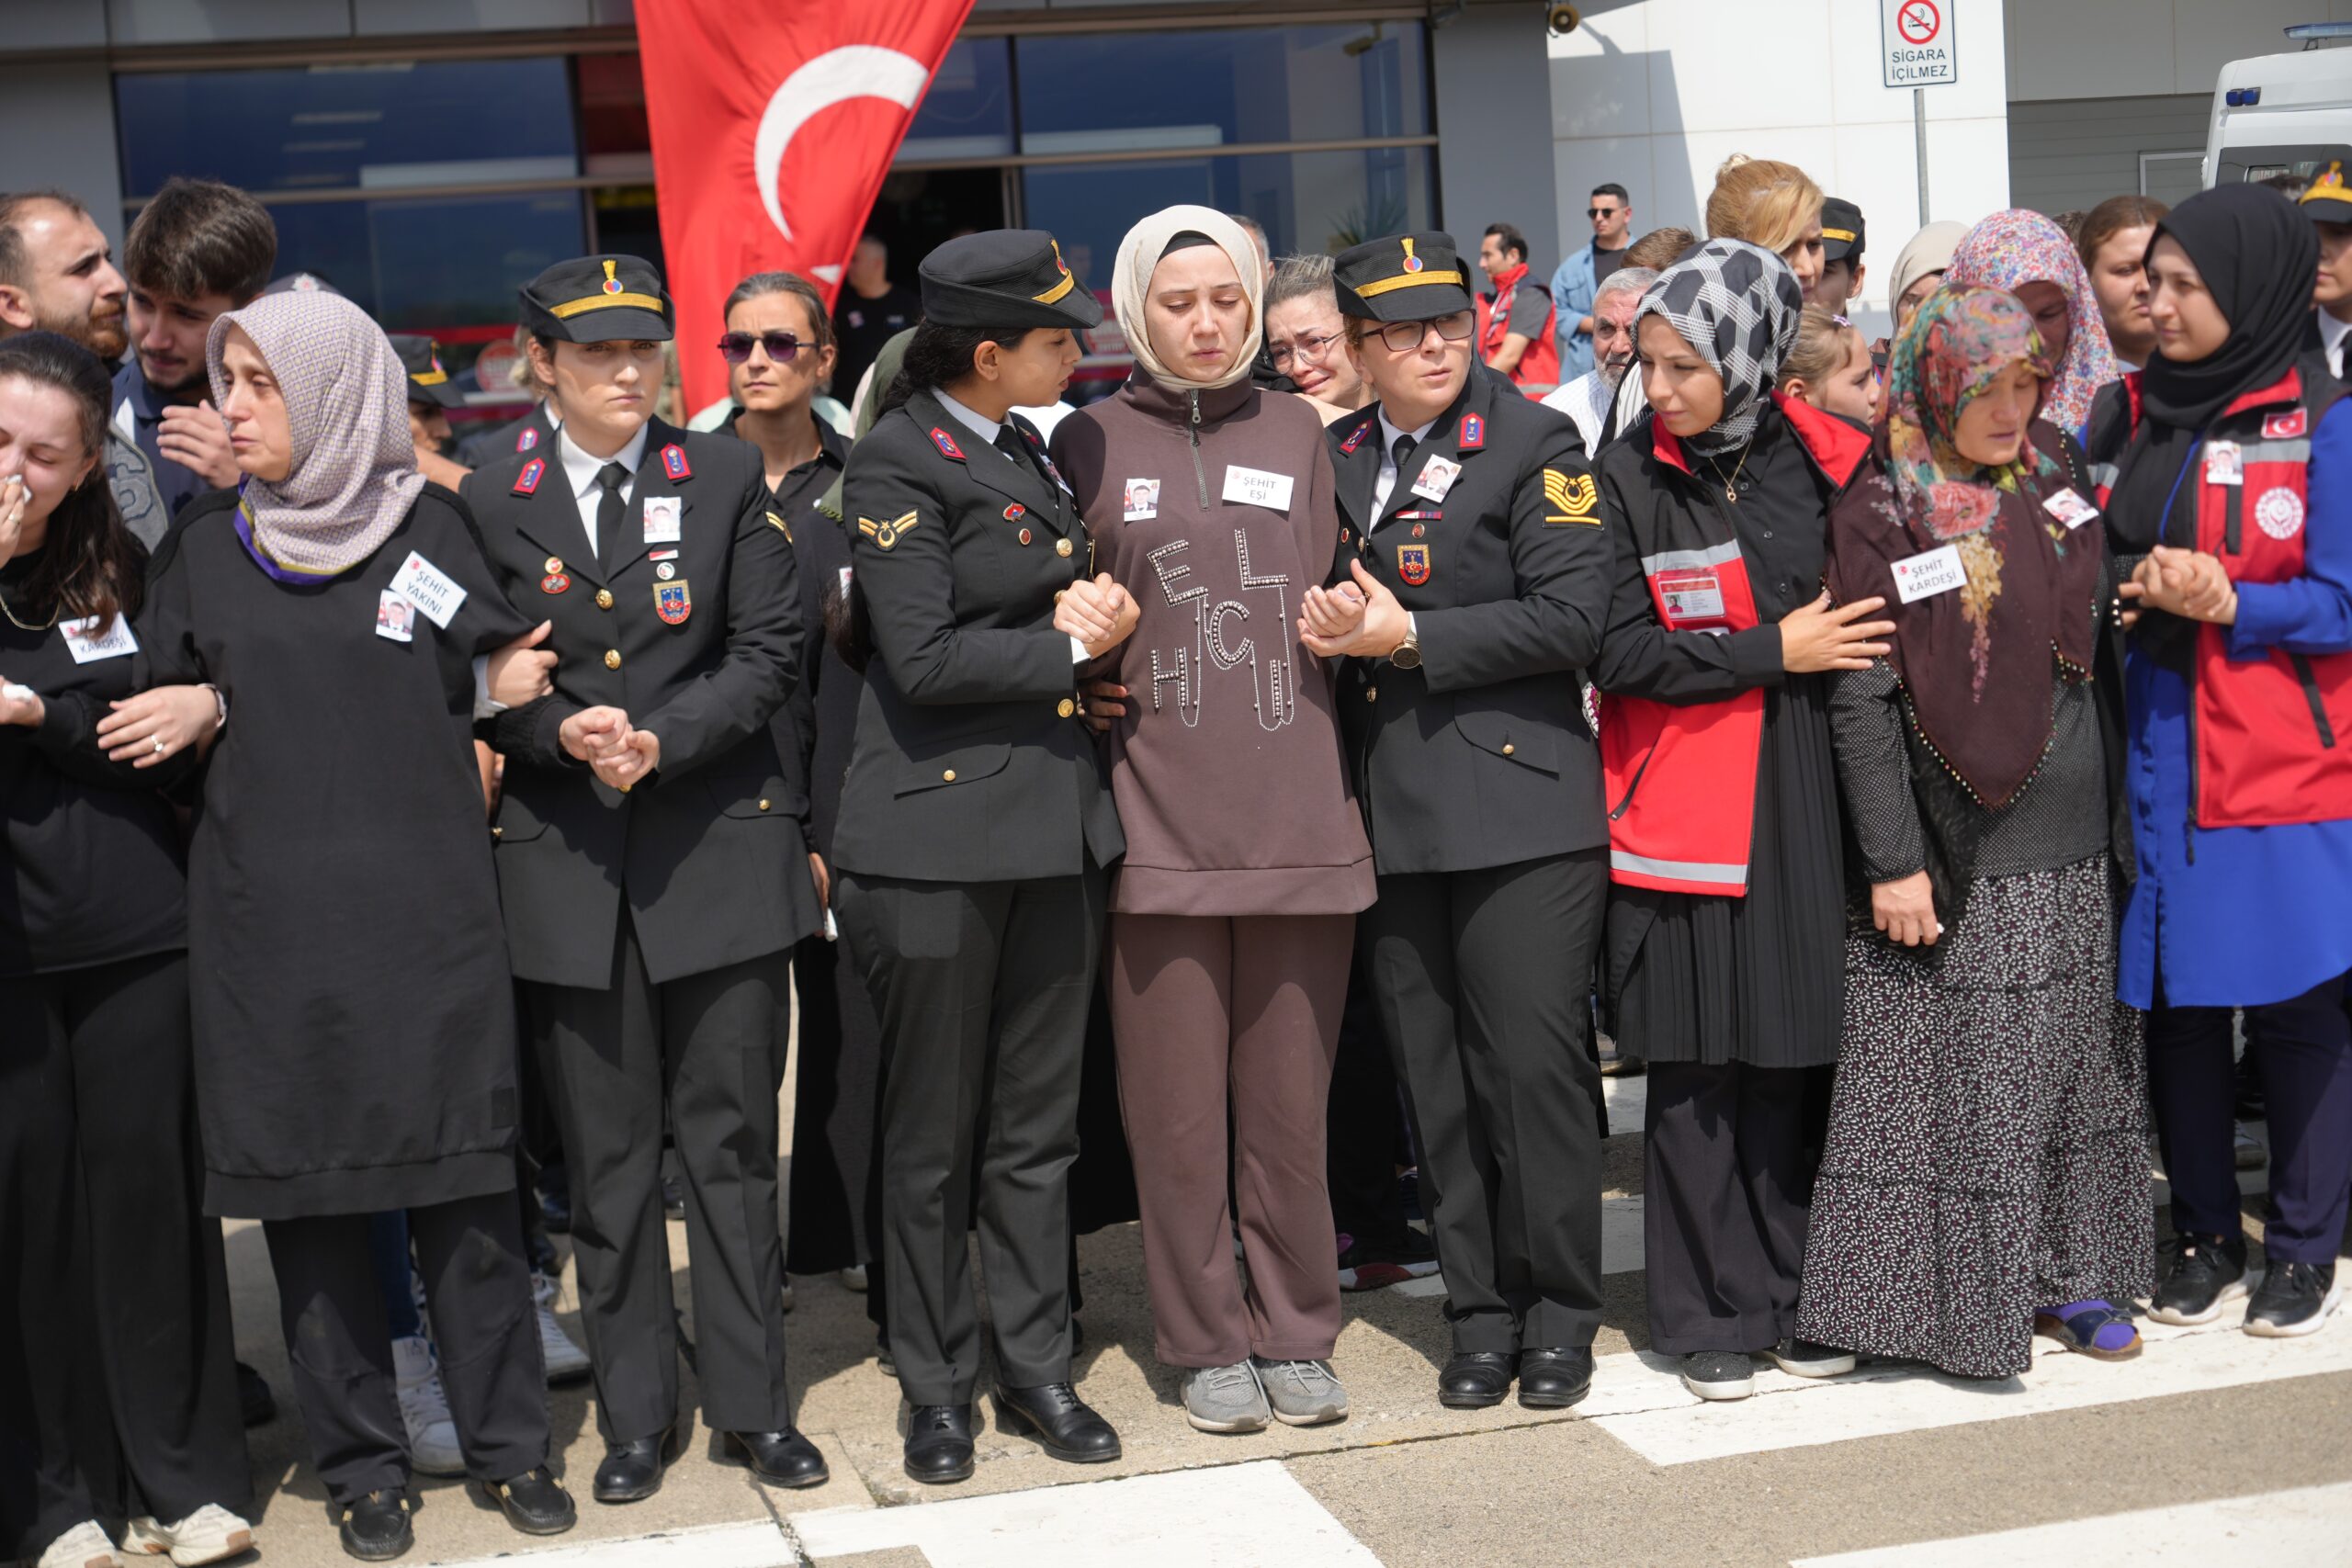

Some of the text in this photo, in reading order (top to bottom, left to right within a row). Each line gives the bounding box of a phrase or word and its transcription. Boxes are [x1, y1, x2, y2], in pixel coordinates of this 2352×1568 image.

[1892, 49, 1946, 63] SİGARA
[1892, 65, 1948, 82] İÇİLMEZ
[1243, 476, 1277, 489] ŞEHİT
[1250, 490, 1267, 501] EŞİ
[1911, 558, 1943, 579] ŞEHİT
[415, 570, 448, 597] ŞEHİT
[1908, 568, 1957, 593] KARDEŞİ
[405, 581, 442, 615] YAKINI
